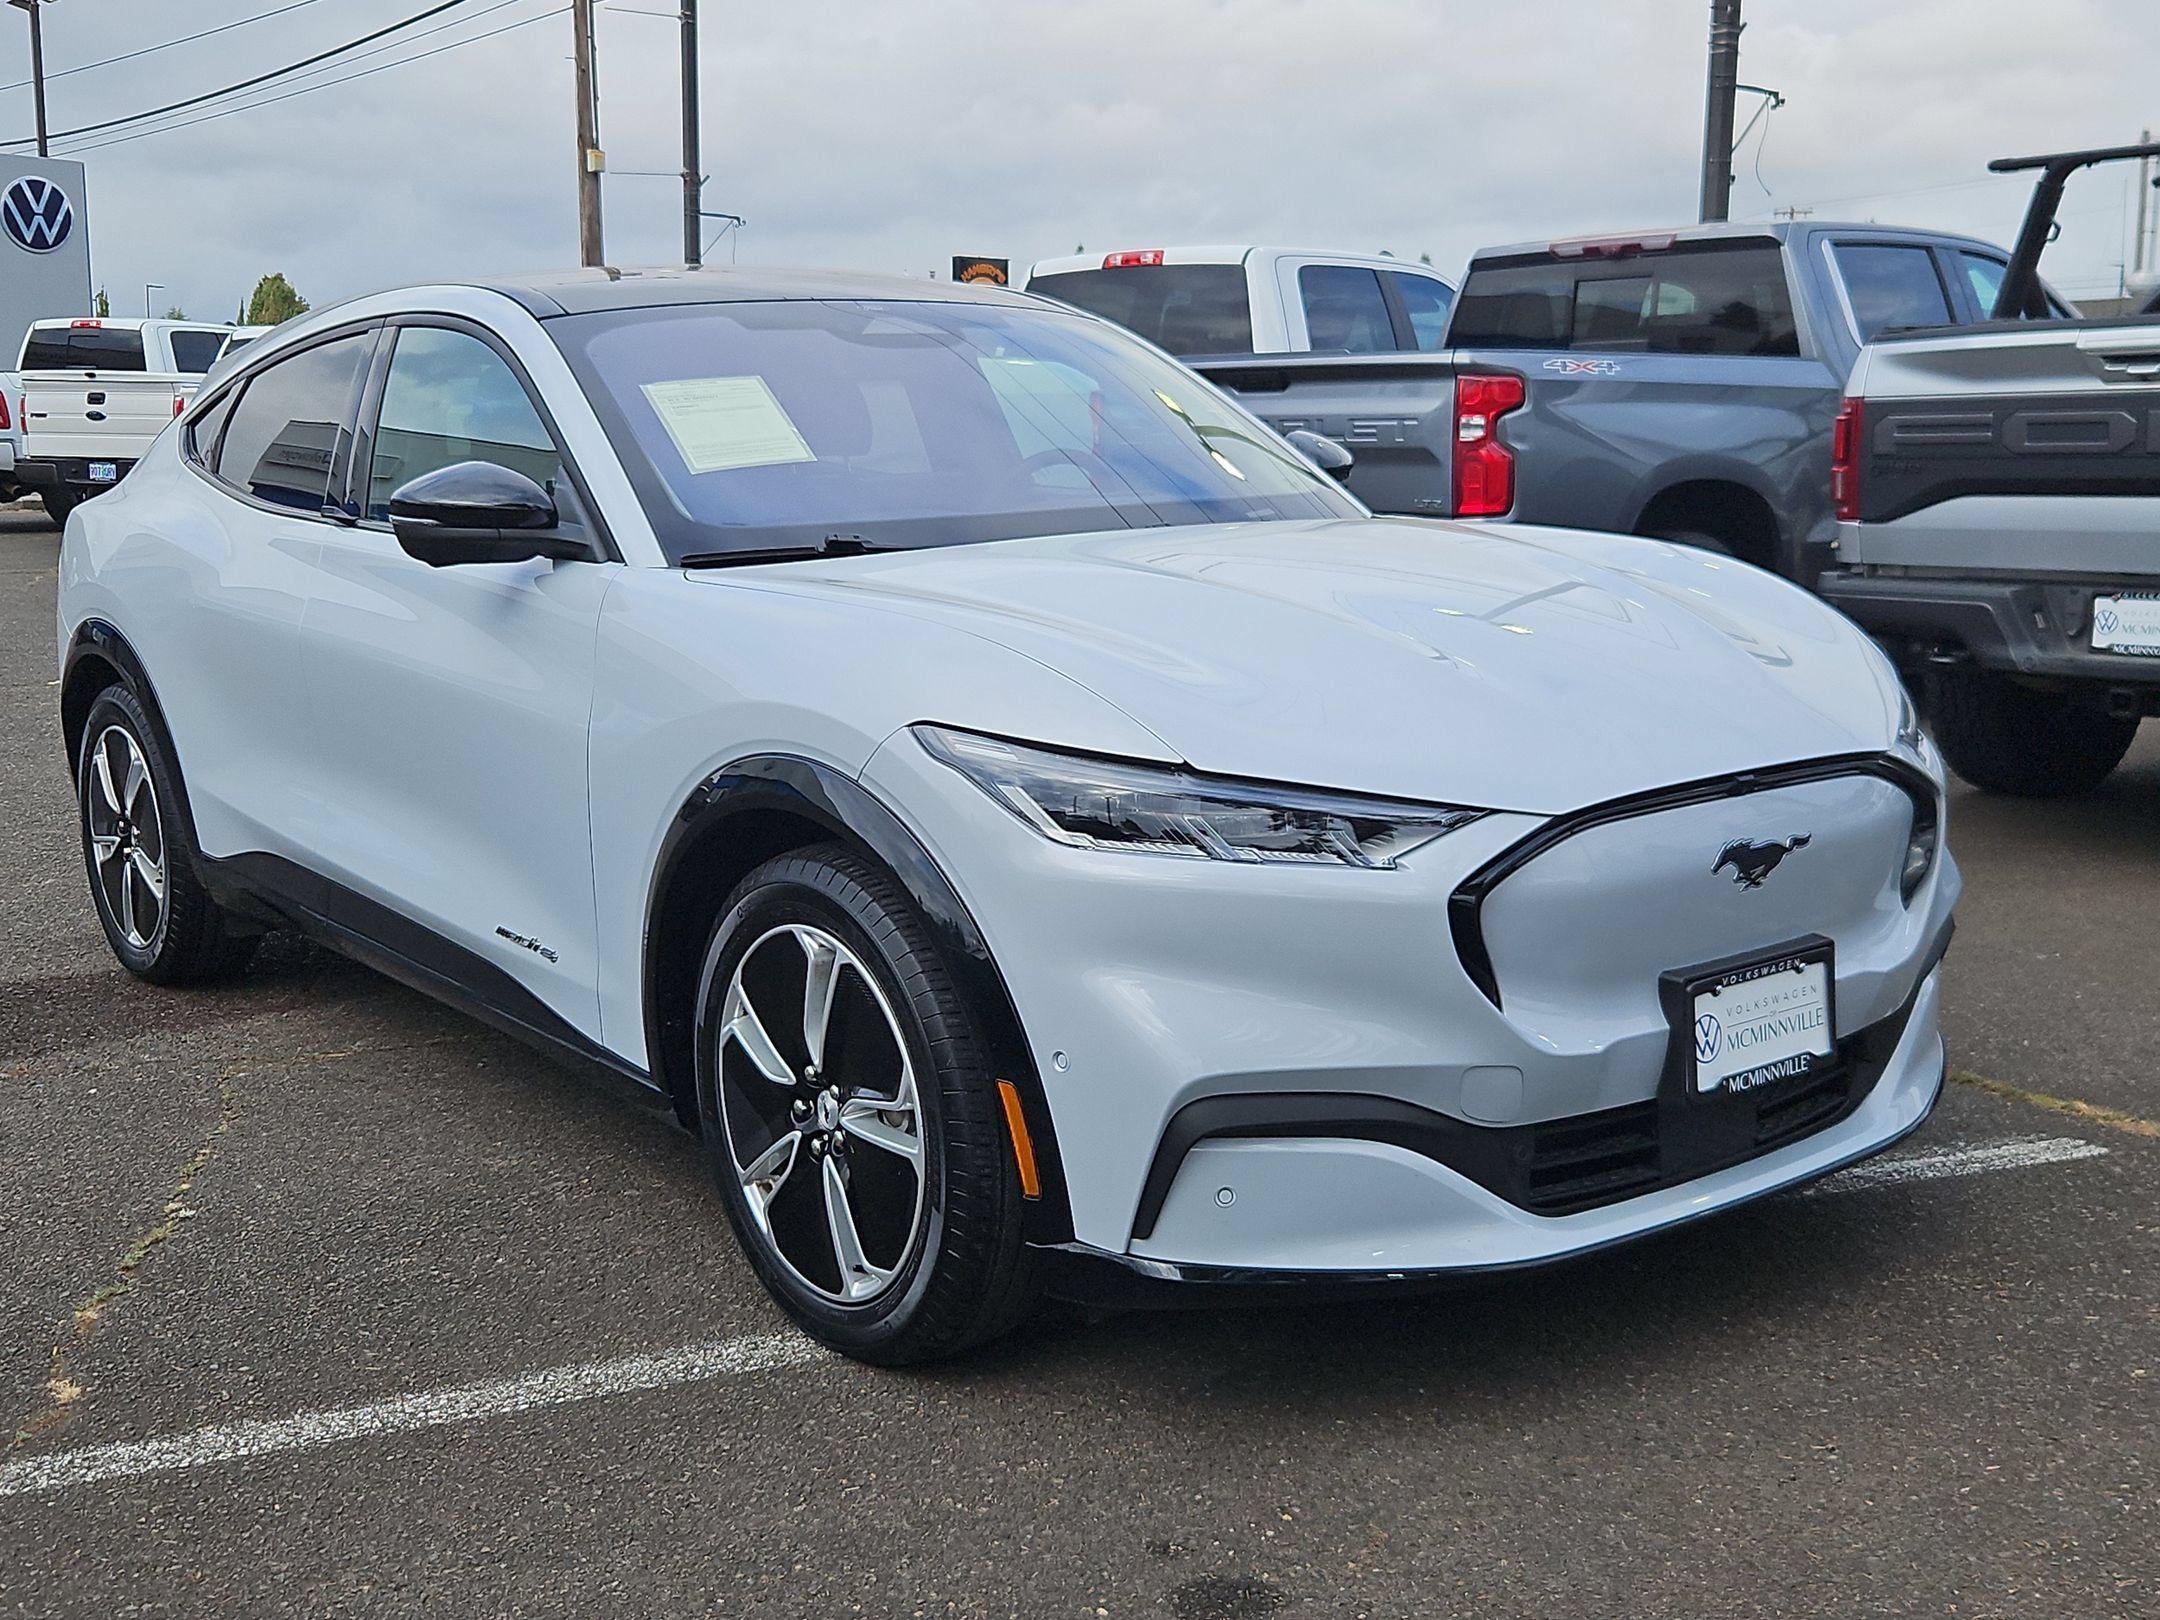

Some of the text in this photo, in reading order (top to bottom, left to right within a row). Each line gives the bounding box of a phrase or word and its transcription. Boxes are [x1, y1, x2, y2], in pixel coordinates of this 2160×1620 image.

[1721, 957, 1801, 986] VOLKSWAGEN
[1726, 984, 1817, 1017] VOLKSWAGEN
[1727, 1006, 1824, 1052] MCMINNVILLE
[1728, 1054, 1809, 1094] MCMINNVILLE
